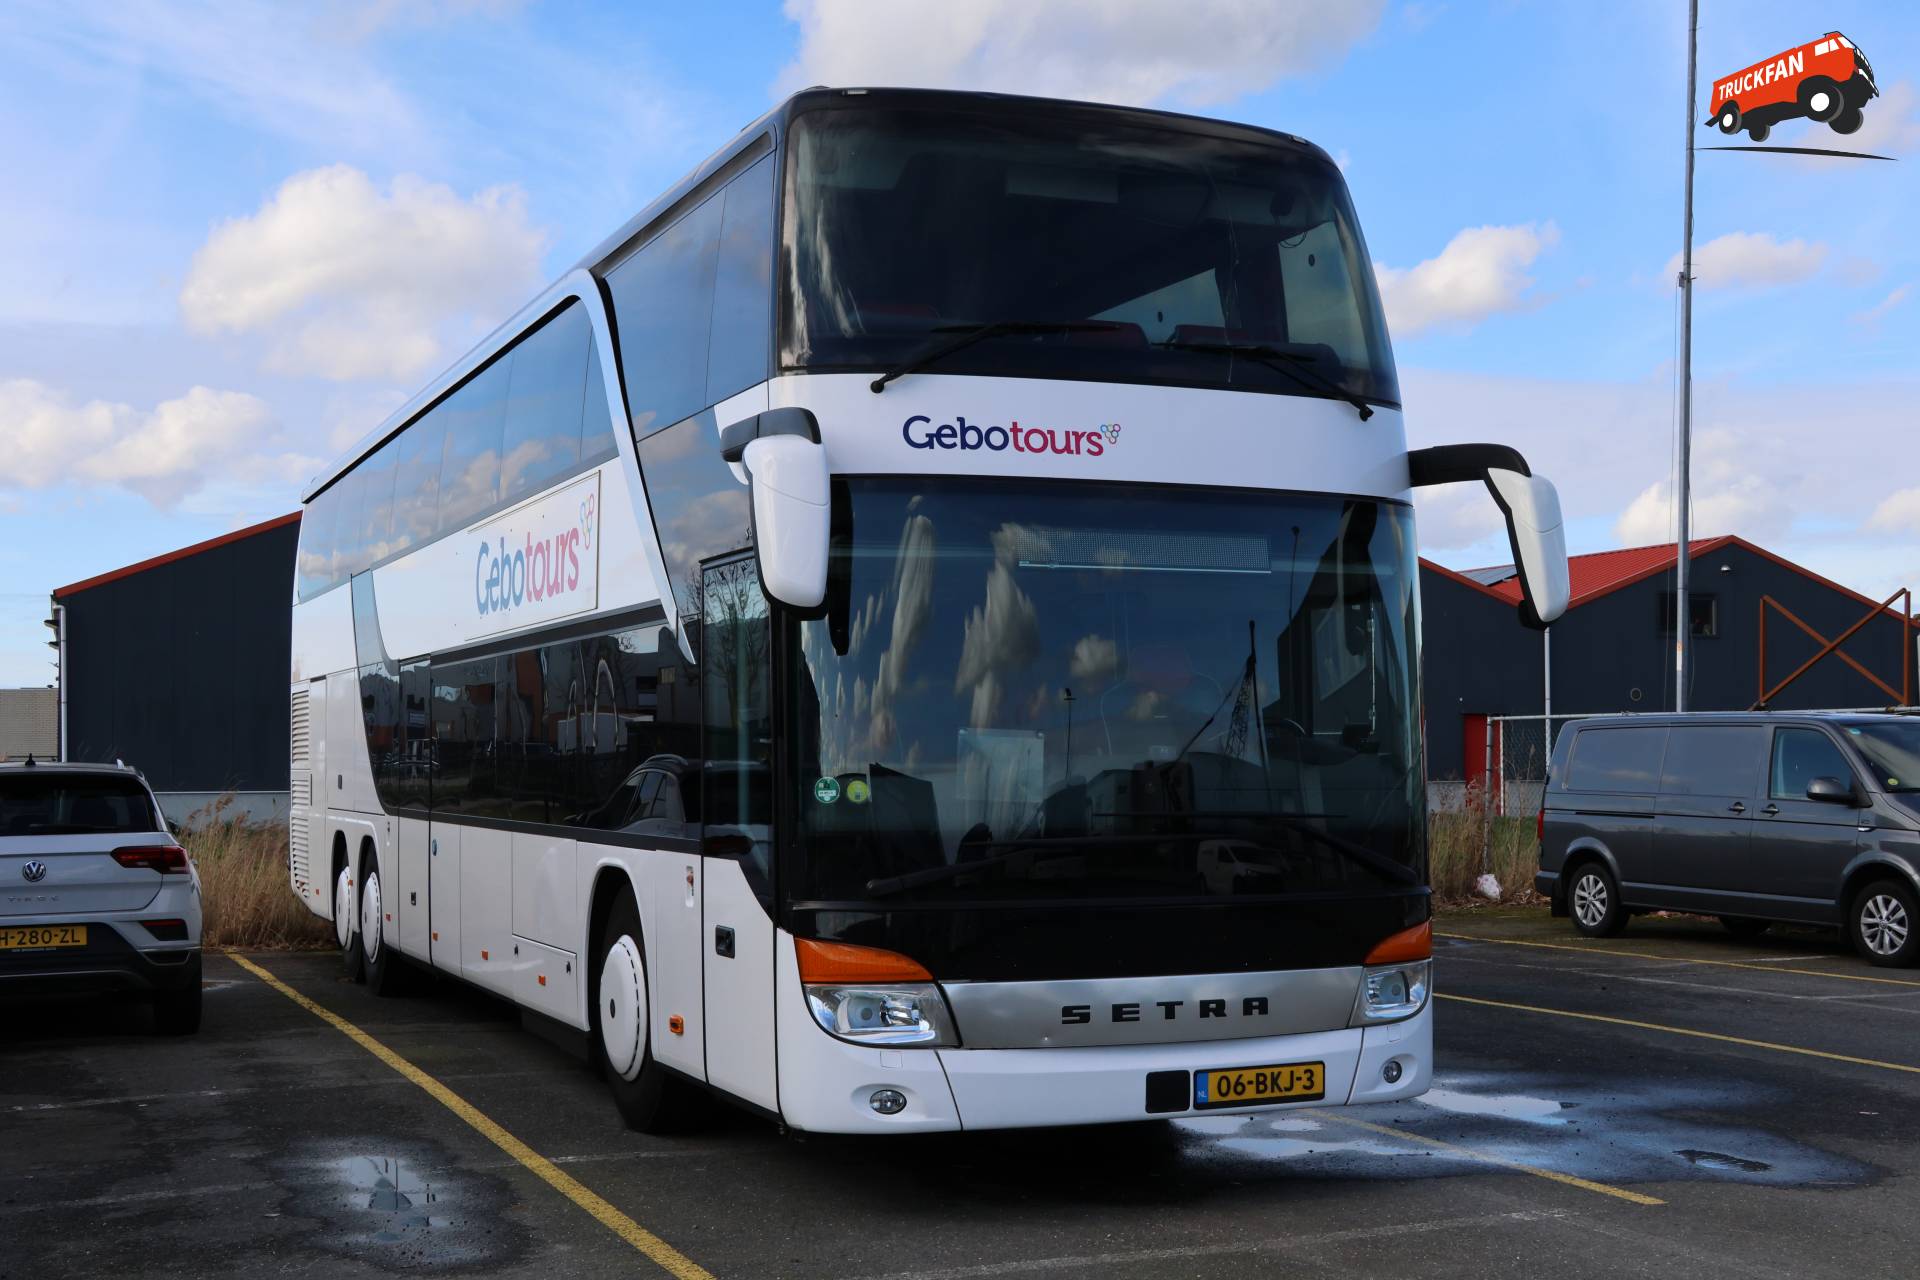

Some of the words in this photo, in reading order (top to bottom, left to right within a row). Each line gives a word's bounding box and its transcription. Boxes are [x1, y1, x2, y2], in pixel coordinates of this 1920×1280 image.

[902, 415, 1104, 457] Gebotours
[476, 527, 579, 615] Gebotours
[1061, 997, 1269, 1024] SETRA
[1216, 1069, 1315, 1098] 06-BKJ-3
